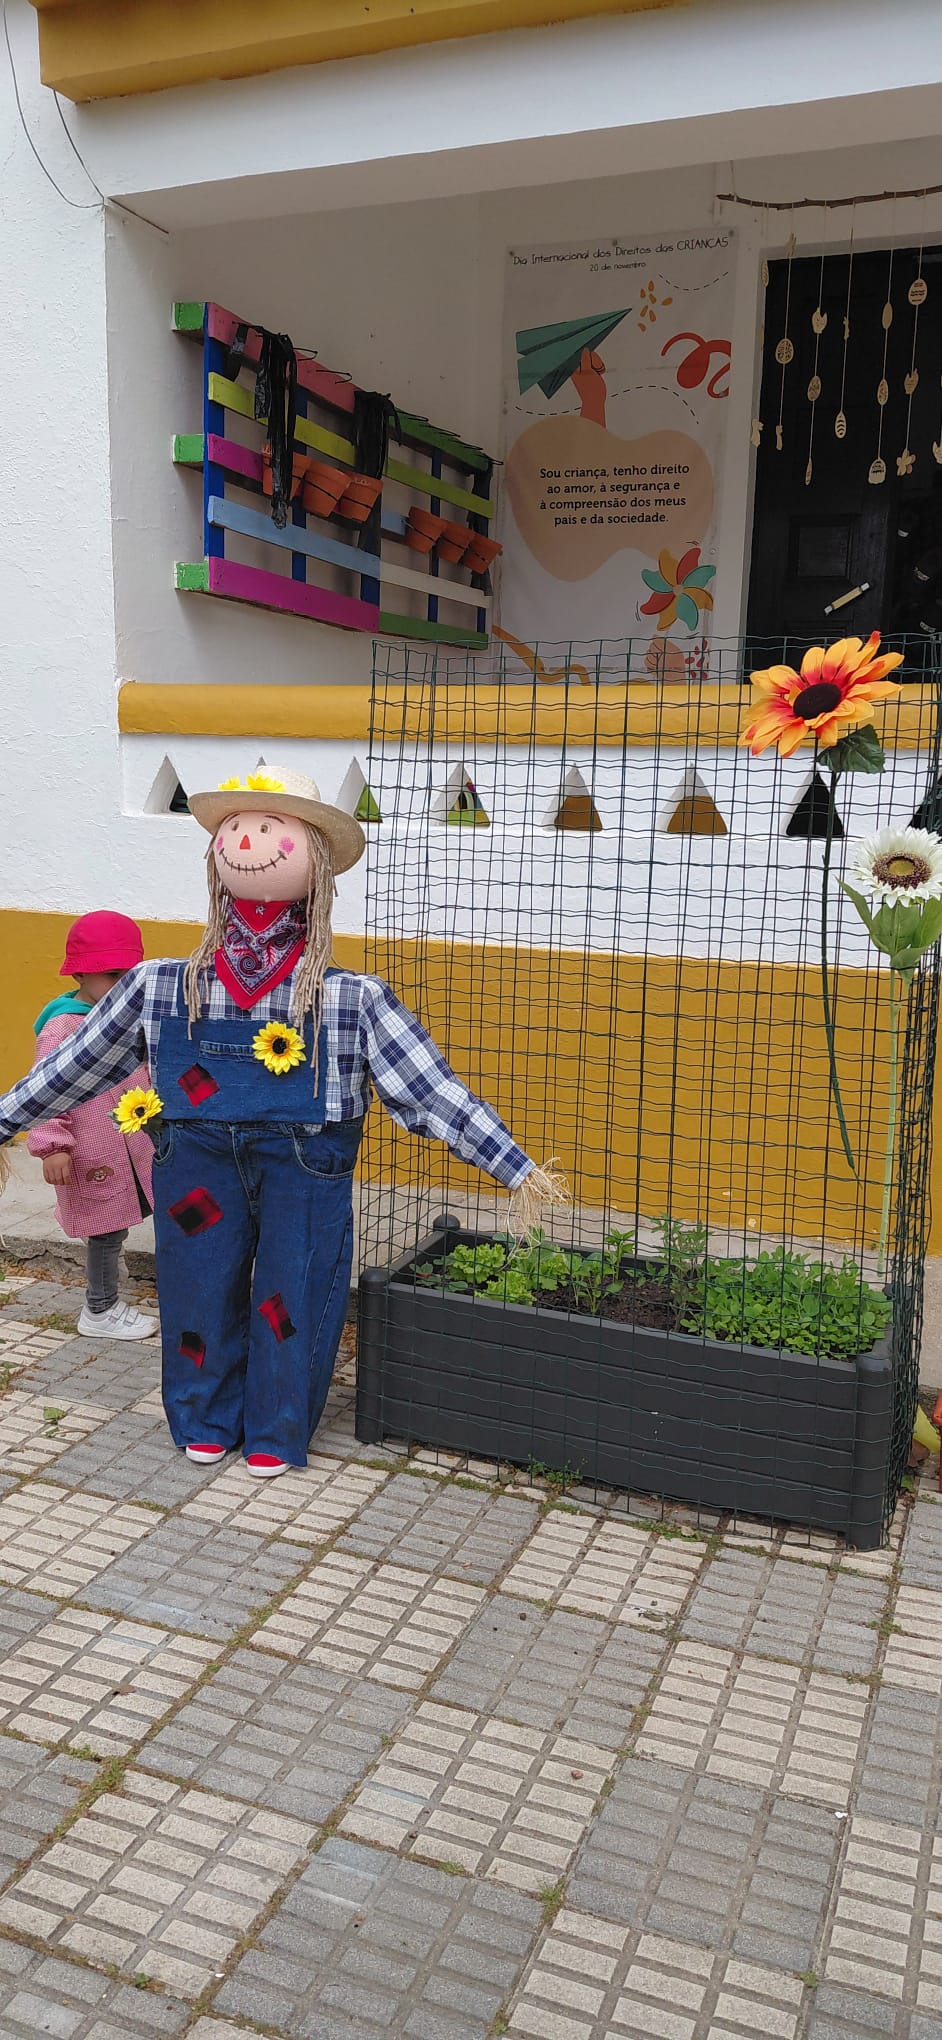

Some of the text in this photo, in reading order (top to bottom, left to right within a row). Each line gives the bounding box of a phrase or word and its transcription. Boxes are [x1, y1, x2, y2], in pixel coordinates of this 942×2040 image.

[513, 255, 528, 266] Dia
[532, 251, 589, 265] Internacional
[593, 247, 612, 258] dos
[615, 246, 651, 257] Direitos
[655, 243, 674, 253] das
[590, 264, 599, 272] 20
[601, 263, 611, 271] de
[540, 464, 689, 480] Sou criança, tenho direito
[547, 485, 561, 494] ao
[564, 484, 597, 494] amor,
[610, 481, 670, 494] segurança
[673, 481, 681, 490] e
[539, 497, 687, 511] à compreensão dos meus
[554, 512, 669, 528] pais e da sociedade.
